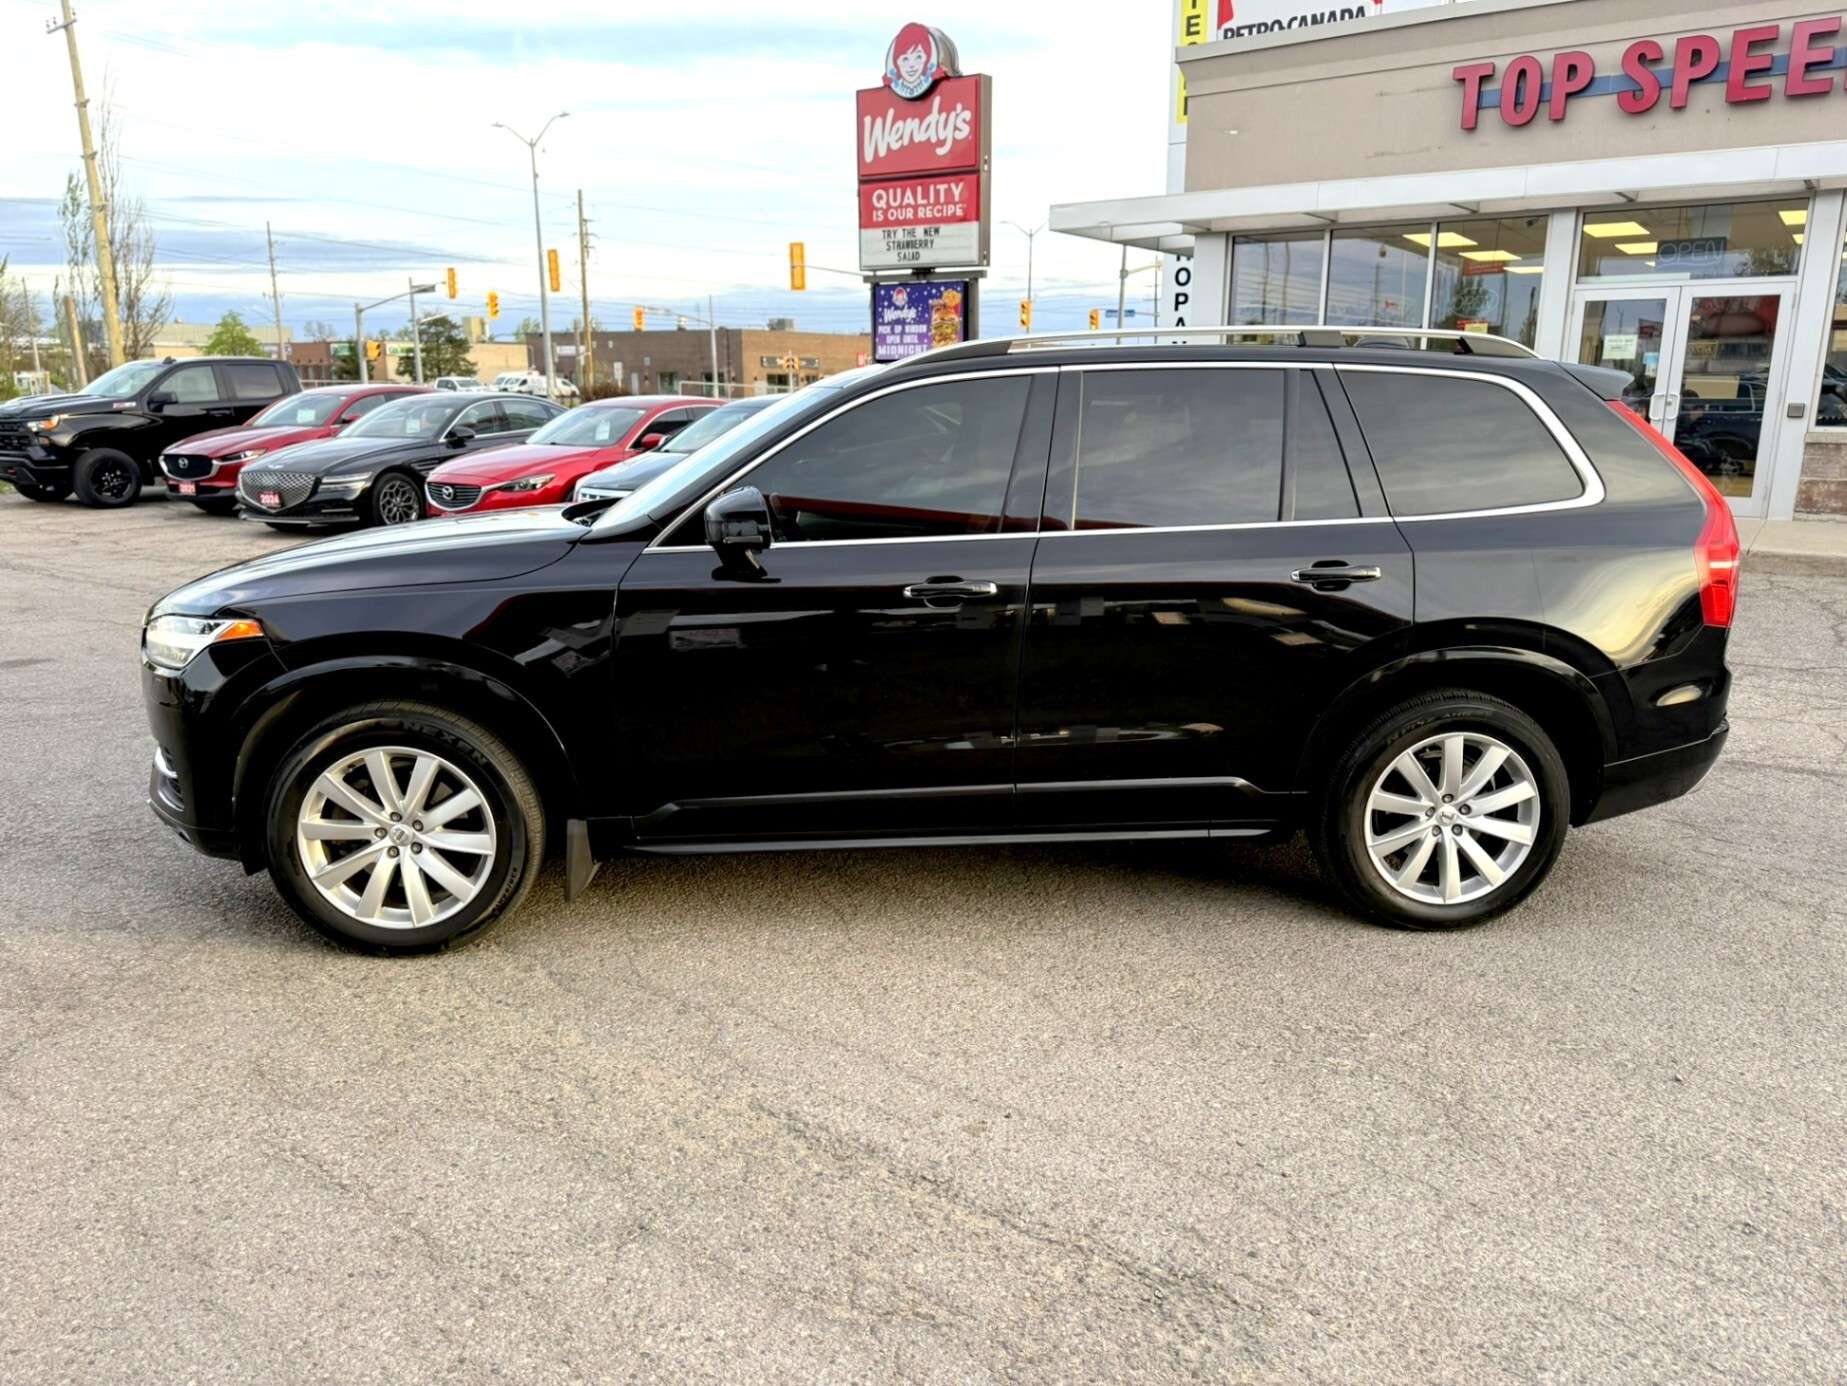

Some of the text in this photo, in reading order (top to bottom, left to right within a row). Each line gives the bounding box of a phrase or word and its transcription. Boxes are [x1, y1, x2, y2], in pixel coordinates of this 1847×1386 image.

[1453, 16, 1847, 131] TOP SPEE
[863, 95, 972, 163] Wendy's
[872, 182, 964, 209] QUALITY
[872, 203, 964, 222] IS OUR RECIPE
[882, 226, 940, 240] TRY THE NEW
[886, 239, 935, 252] STRAWBERRY
[897, 251, 920, 262] SALAD
